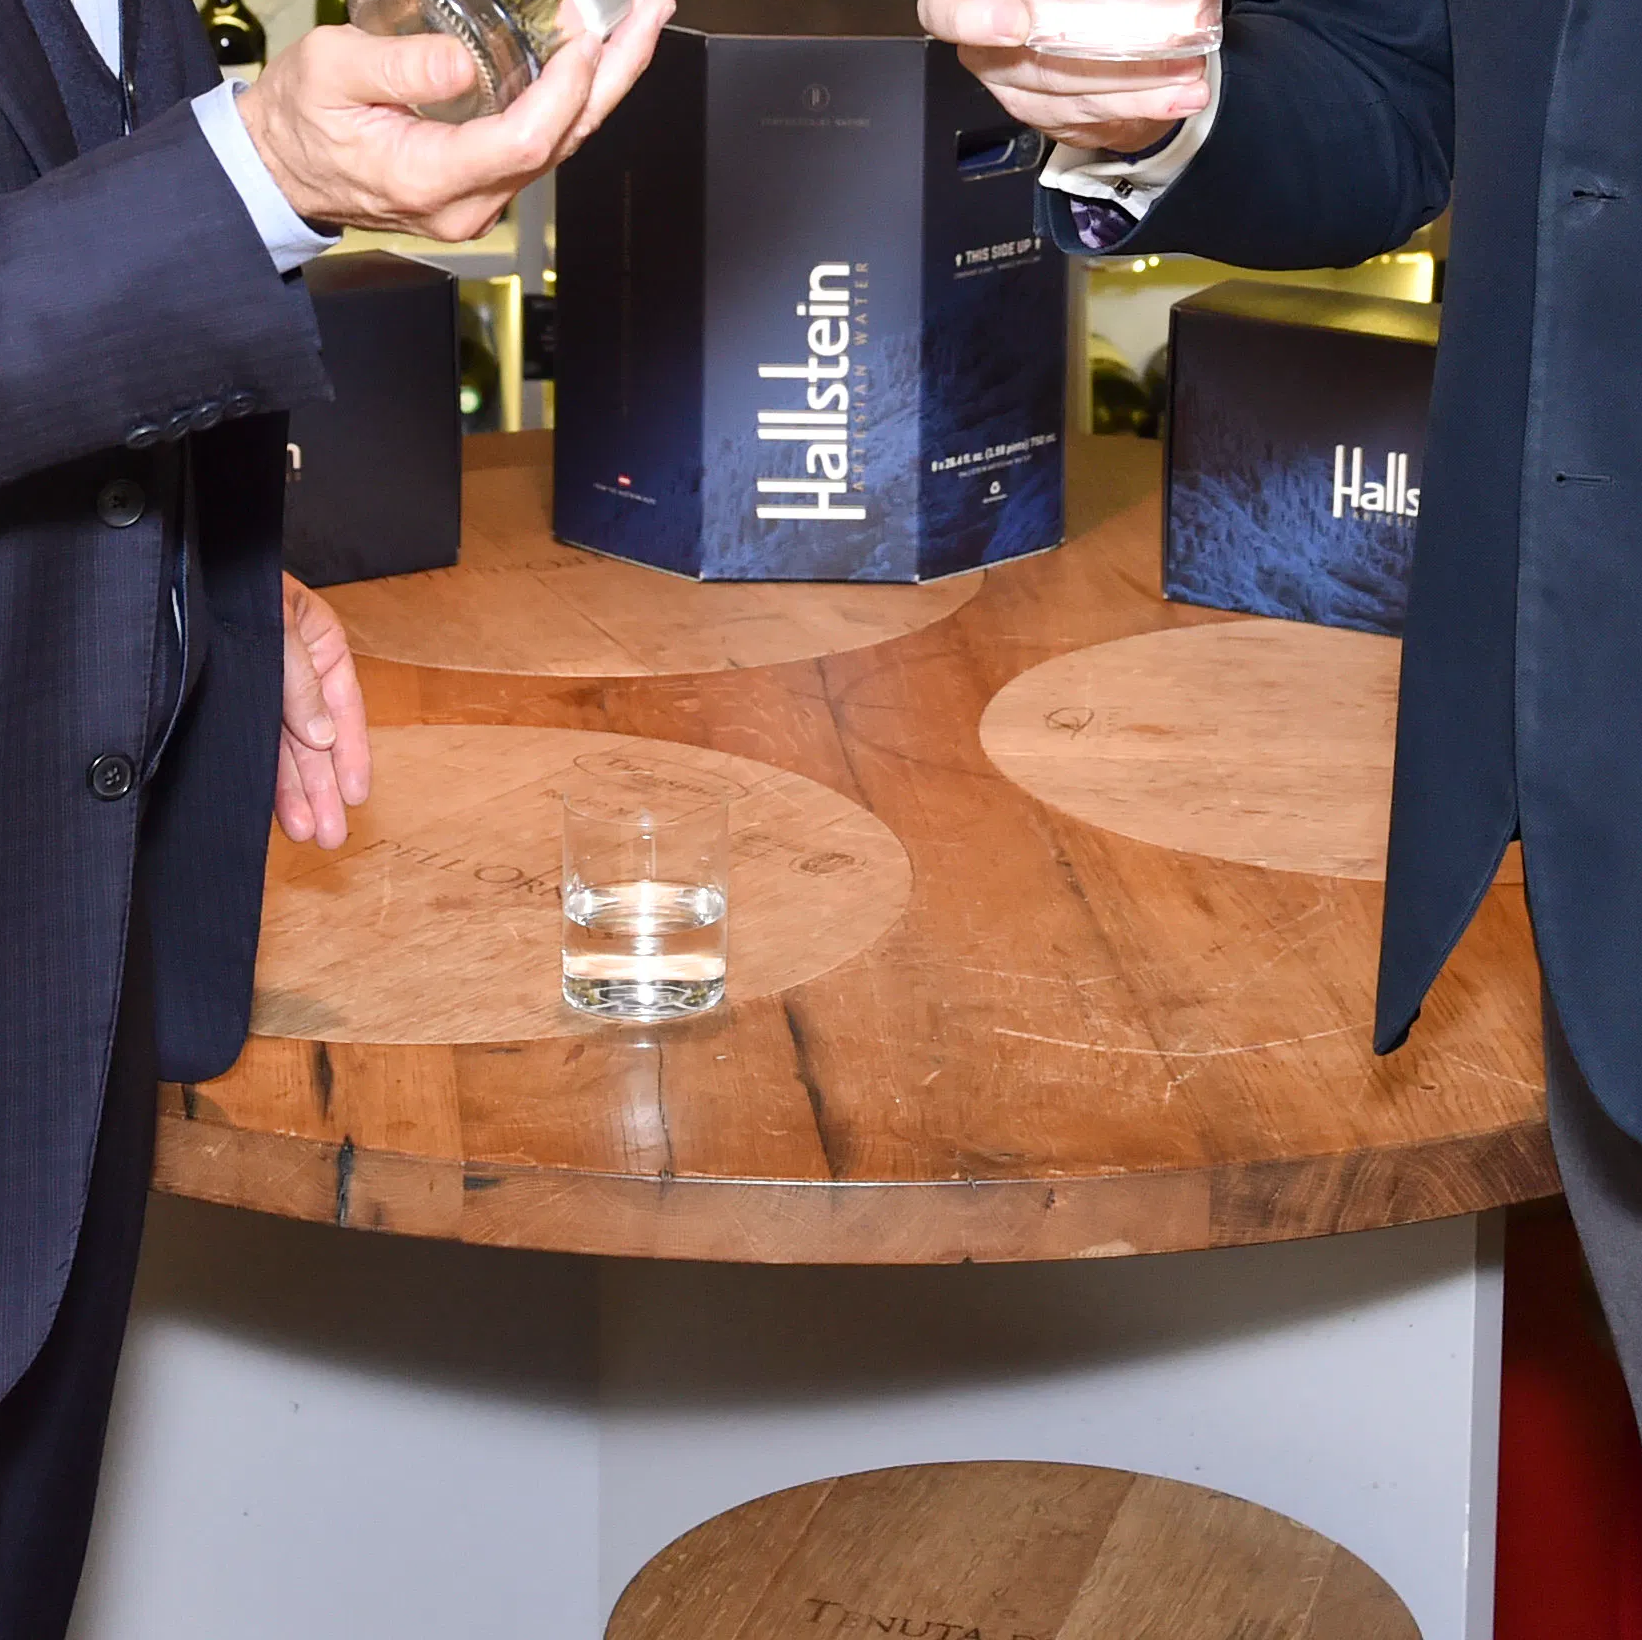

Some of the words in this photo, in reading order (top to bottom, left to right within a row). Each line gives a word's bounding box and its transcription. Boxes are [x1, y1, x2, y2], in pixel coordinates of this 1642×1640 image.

[965, 247, 990, 264] THIS
[991, 241, 1015, 259] SIDE
[1017, 238, 1032, 254] UP
[853, 262, 869, 346] WATER
[756, 262, 866, 520] Hallstein
[853, 365, 868, 492] ARTESIAN
[1333, 444, 1421, 518] Halls
